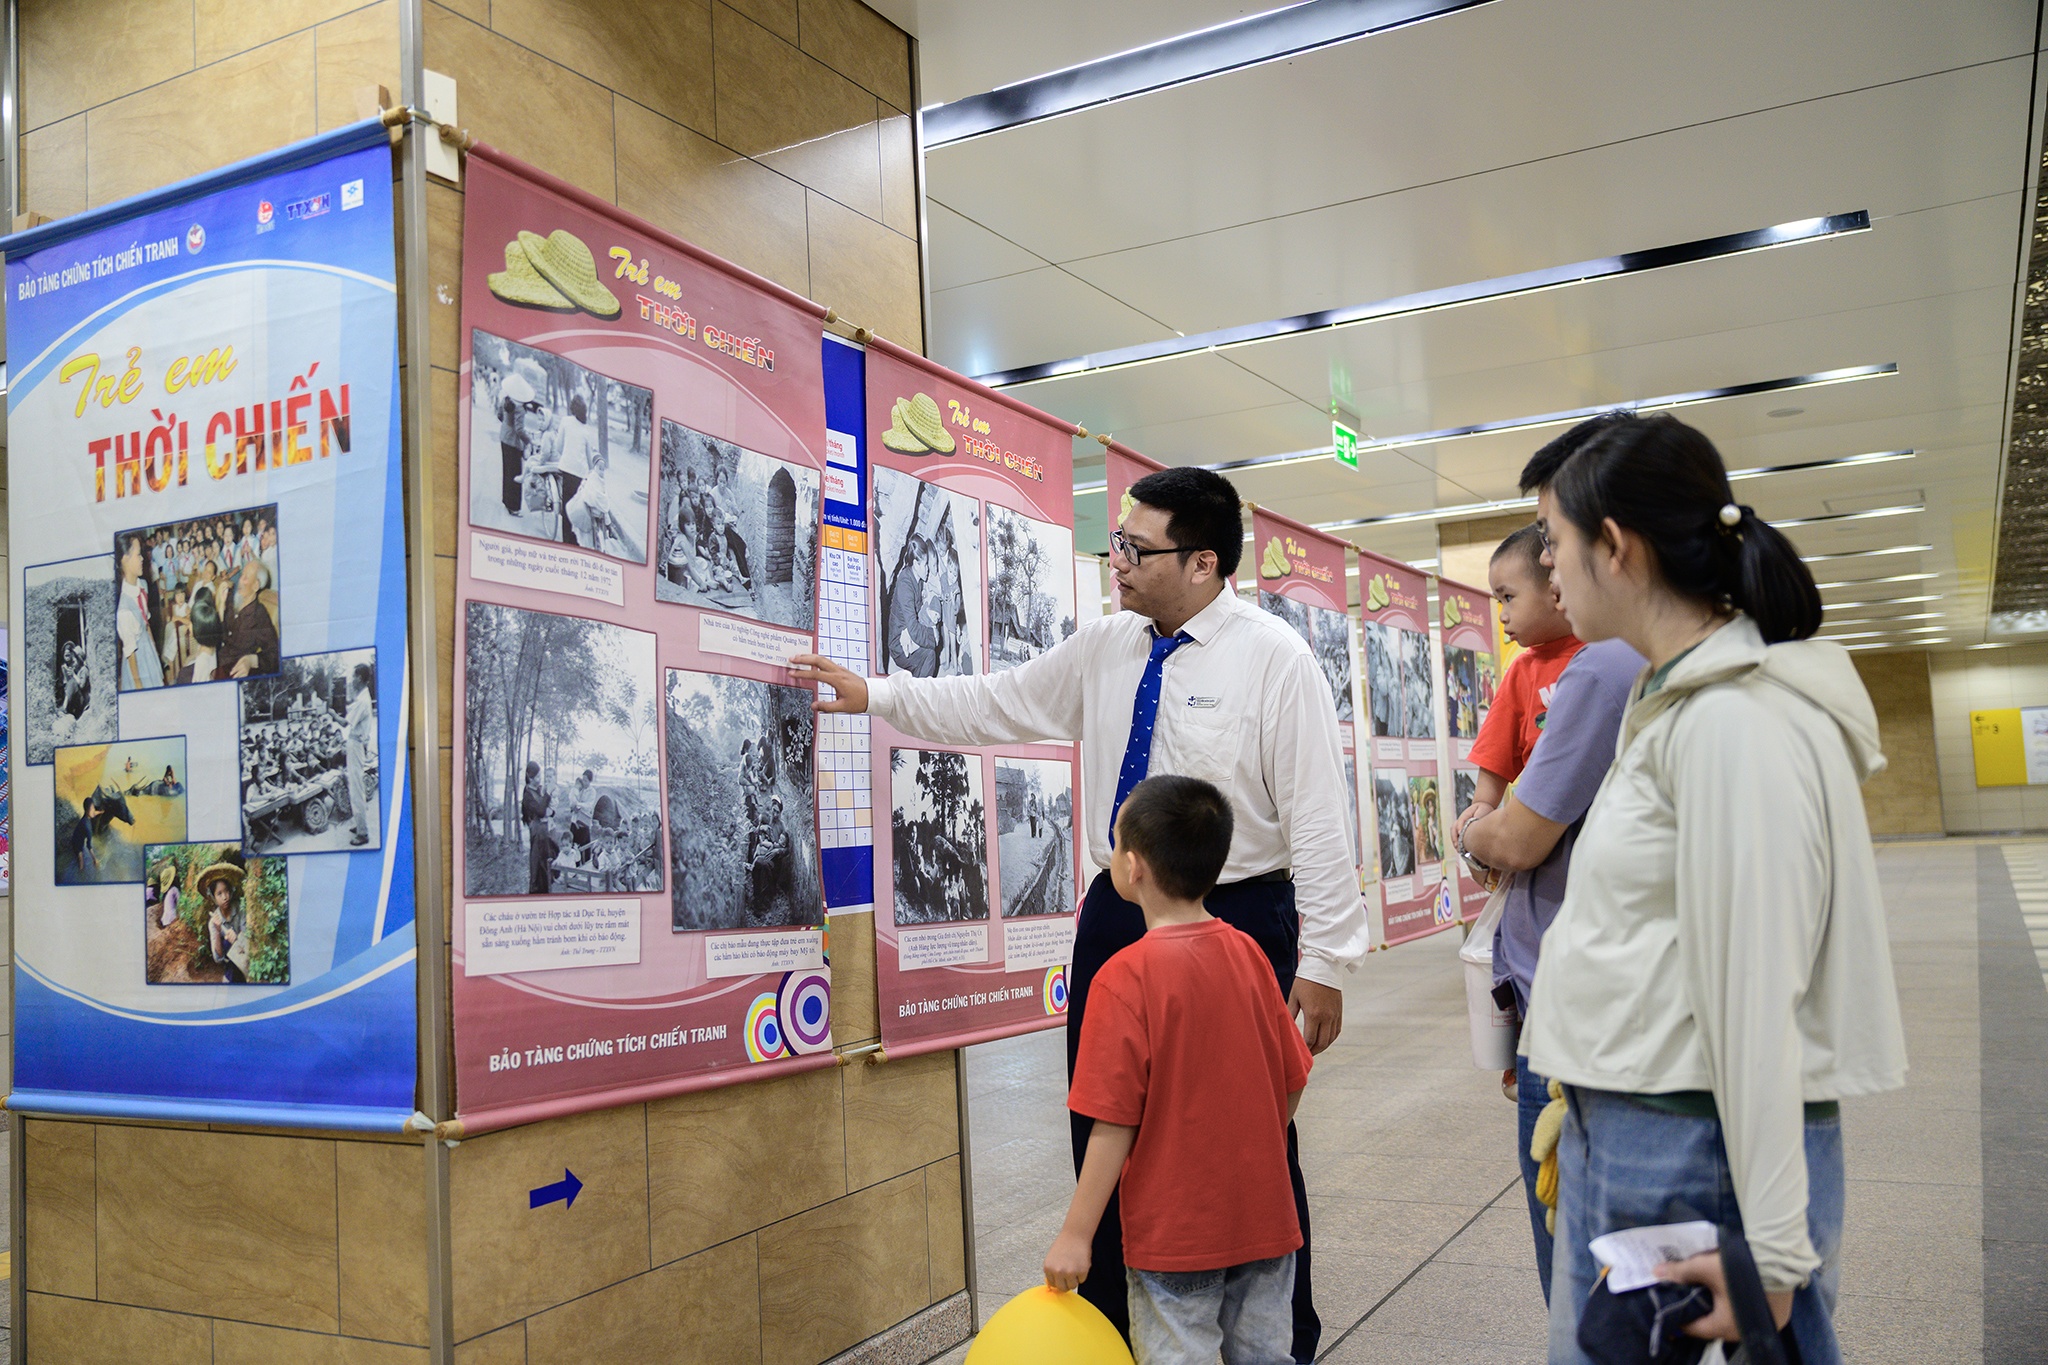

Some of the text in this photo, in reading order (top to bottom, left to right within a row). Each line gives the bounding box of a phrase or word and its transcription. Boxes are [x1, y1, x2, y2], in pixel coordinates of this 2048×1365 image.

[18, 236, 179, 301] BẢO TÀNG CHỨNG TÍCH CHIẾN TRANH
[609, 246, 682, 300] Trẻ em
[636, 294, 774, 372] THỜI CHIẾN
[60, 344, 238, 419] Trẻ em
[88, 361, 351, 502] THỜI CHIẾN
[972, 417, 991, 435] em
[962, 434, 1043, 483] THỜI CHIẾN
[483, 912, 496, 921] Các
[500, 925, 513, 933] Anh
[899, 985, 1033, 1018] BẢO TÀNG CHỨNG TÍCH CHIẾN TRANH
[489, 1024, 727, 1073] BẢO TÀNG CHỨNG TÍCH CHIẾN TRANH
